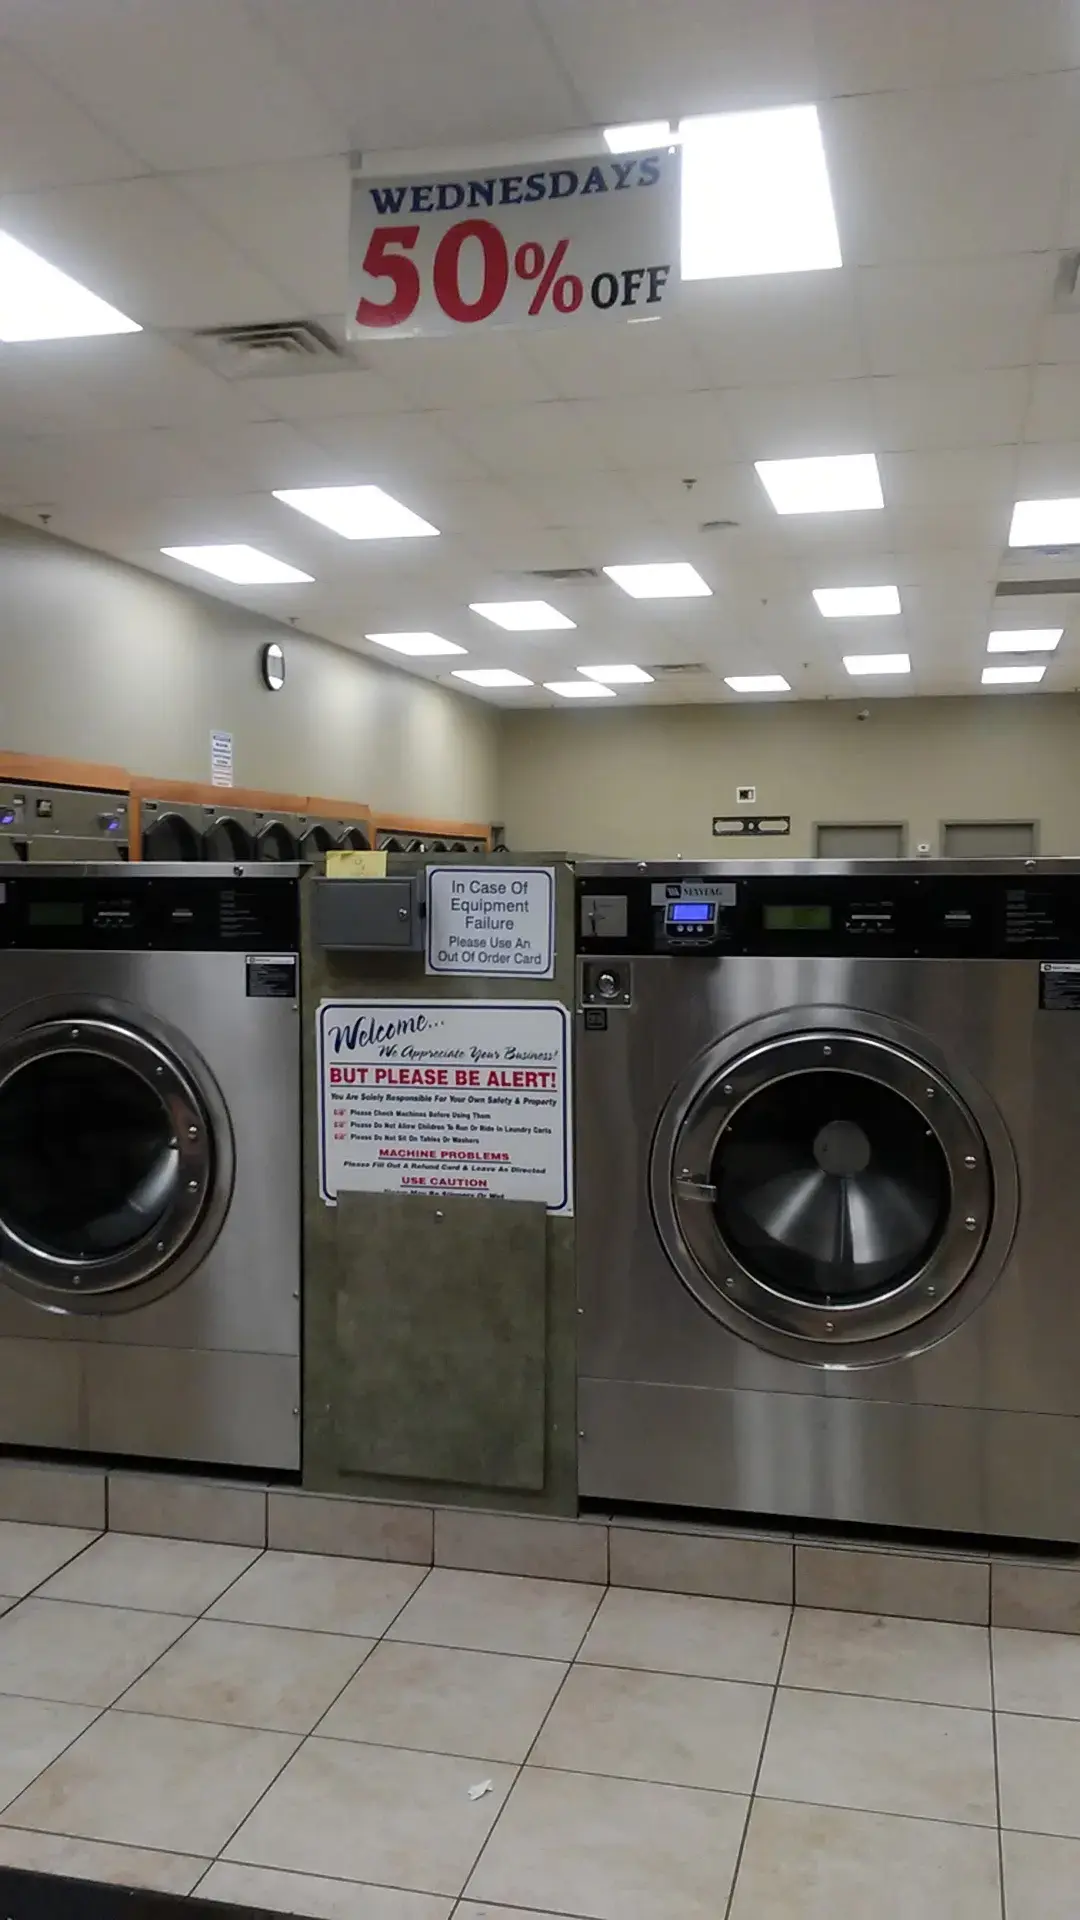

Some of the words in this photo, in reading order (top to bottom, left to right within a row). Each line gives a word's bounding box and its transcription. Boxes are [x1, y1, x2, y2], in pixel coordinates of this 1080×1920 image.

[370, 156, 661, 214] WEDNESDAYS
[355, 218, 584, 328] 50%
[591, 265, 670, 309] OFF
[452, 880, 465, 894] In
[470, 881, 506, 894] Case
[511, 881, 528, 895] Of
[451, 898, 529, 915] Equipment
[465, 916, 514, 930] Failure
[449, 936, 486, 949] Please
[490, 937, 511, 949] Use
[516, 938, 530, 949] An
[438, 951, 458, 962] Out
[462, 952, 475, 963] Of
[480, 952, 511, 964] Order
[514, 953, 541, 965] Card
[328, 1014, 445, 1054] Welcome...
[379, 1044, 397, 1057] We
[401, 1045, 465, 1060] Appreciate
[470, 1046, 499, 1062] Your
[504, 1045, 558, 1061] Business!
[330, 1067, 368, 1083] BUT
[375, 1068, 448, 1085] PLEASE
[456, 1070, 480, 1086] BE
[487, 1071, 557, 1088] ALERT!
[331, 1093, 344, 1101] You
[361, 1093, 384, 1103] Solely
[386, 1094, 431, 1103] Responsible
[468, 1096, 485, 1104] Own
[488, 1097, 512, 1106] Safety
[523, 1098, 557, 1107] Property
[396, 1110, 426, 1118] Machines
[452, 1112, 470, 1120] Using
[350, 1121, 372, 1129] Please
[398, 1122, 415, 1130] Allow
[505, 1126, 531, 1134] Laundry
[533, 1126, 552, 1134] Carts
[350, 1133, 372, 1141] Please
[420, 1135, 440, 1143] Tables
[379, 1149, 436, 1158] MACHINE
[441, 1151, 509, 1161] PROBLEMS
[411, 1163, 440, 1171] Refund
[511, 1166, 546, 1174] Directed
[402, 1177, 426, 1185] USE
[430, 1178, 487, 1187] CAUTION
